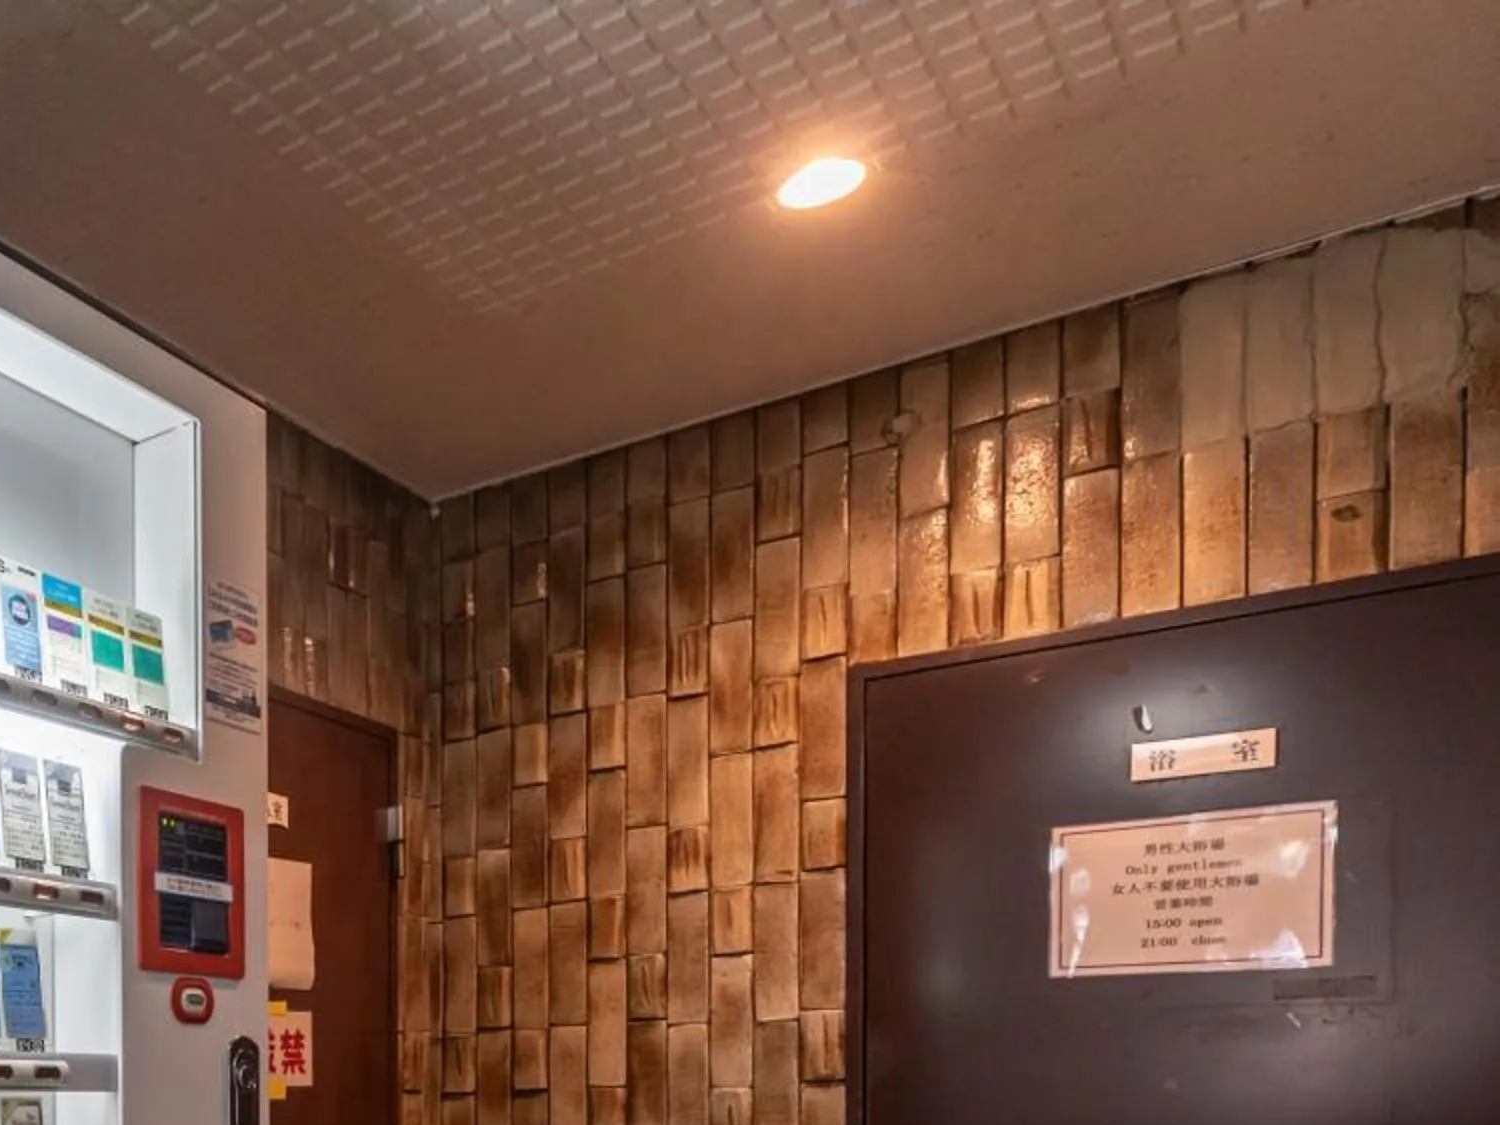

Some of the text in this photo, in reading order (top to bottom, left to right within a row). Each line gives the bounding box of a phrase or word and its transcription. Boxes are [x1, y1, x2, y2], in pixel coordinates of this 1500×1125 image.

[1125, 863, 1158, 875] Only
[1146, 917, 1182, 929] 15:00
[1140, 936, 1178, 949] 21:00
